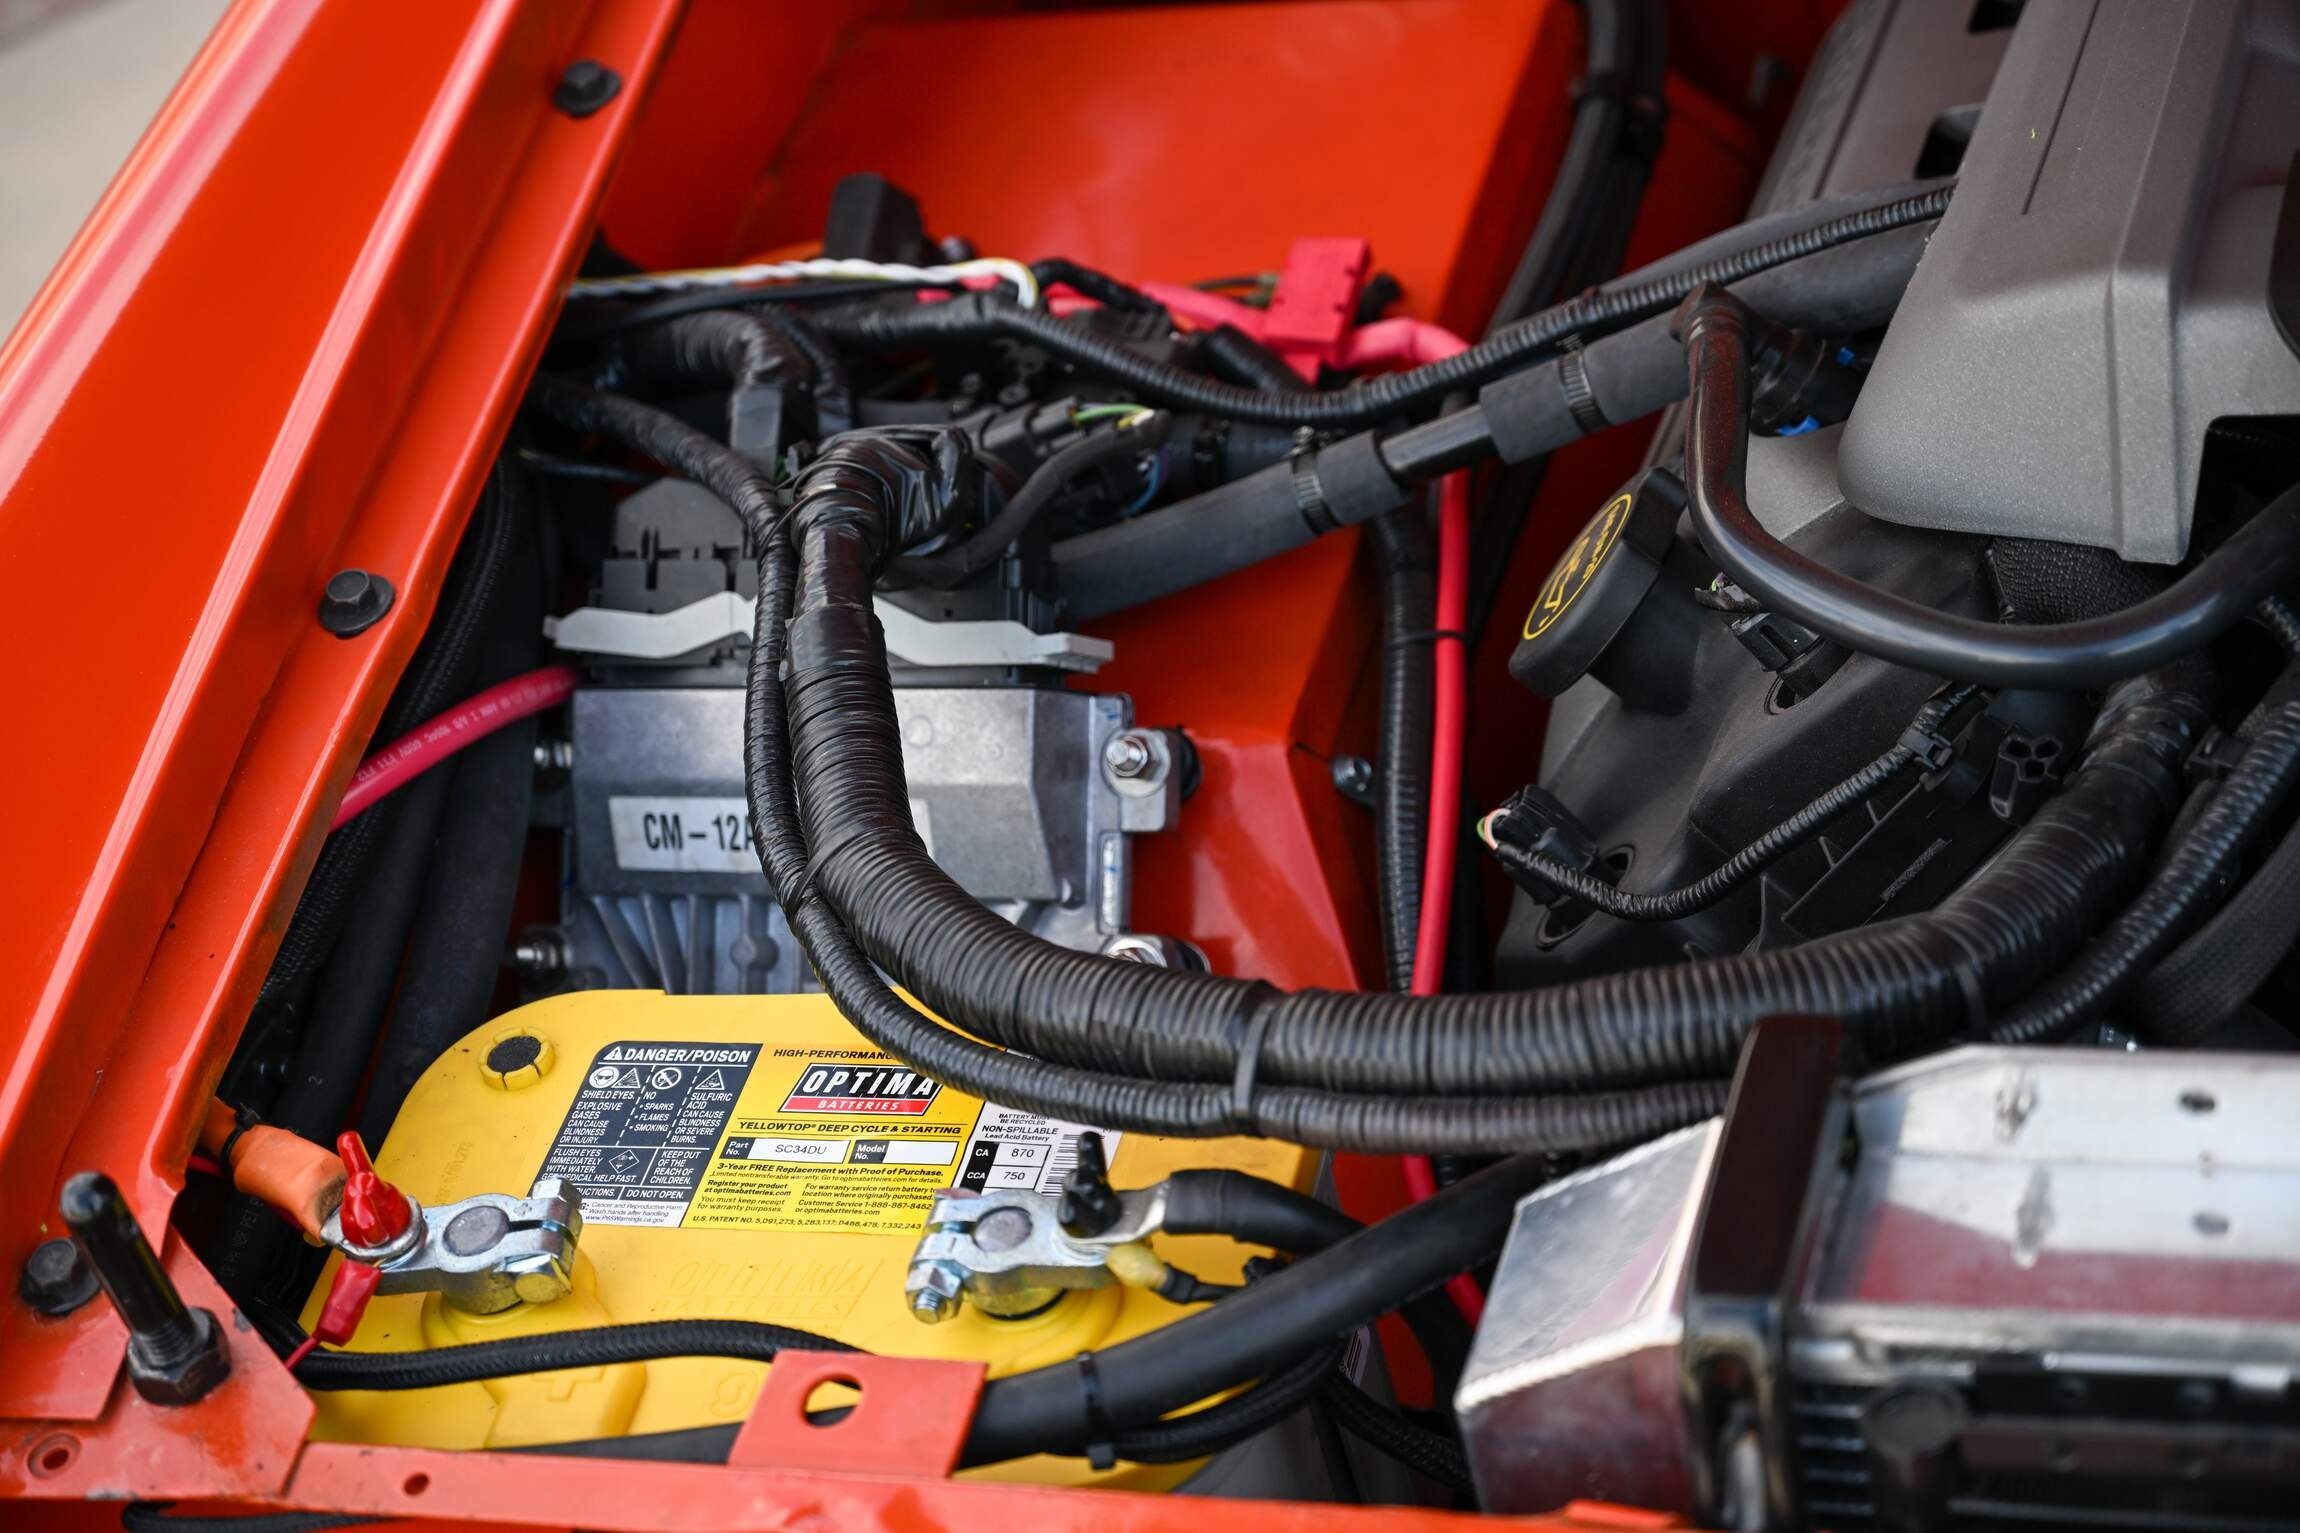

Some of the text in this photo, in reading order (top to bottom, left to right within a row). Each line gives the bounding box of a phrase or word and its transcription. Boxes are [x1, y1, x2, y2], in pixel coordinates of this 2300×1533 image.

[624, 1048, 751, 1063] DANGER/POISON
[802, 1070, 935, 1096] OPTIMA
[582, 1090, 635, 1100] SHIELD EYES.
[643, 1091, 657, 1100] NO
[691, 1092, 733, 1102] SULFURIC
[576, 1101, 623, 1111] EXPLOSIVE
[644, 1103, 674, 1111] SPARKS
[686, 1101, 707, 1109] ACID
[818, 1100, 900, 1111] BATTERIES
[571, 1111, 601, 1119] GASES
[639, 1113, 670, 1121] FLAMES
[699, 1111, 725, 1119] CAUSE
[584, 1120, 609, 1128] CAUSE
[678, 1119, 721, 1127] BLINDNESS
[563, 1128, 606, 1136] BLINDNESS
[634, 1124, 669, 1132] SMOKING
[817, 1124, 850, 1132] DEEP
[850, 1125, 890, 1133] CYCLE
[901, 1126, 961, 1134] STARTING
[982, 1125, 1059, 1135] NON-SPILLABLE
[728, 1141, 749, 1149] Part
[856, 1144, 886, 1153] Model
[553, 1148, 602, 1157] FLUSH EYES
[775, 1144, 827, 1155] SC34DU
[975, 1149, 989, 1157] CA
[1011, 1149, 1034, 1158] 870
[549, 1157, 603, 1165] IMMEDIATELY
[658, 1159, 670, 1167] OF
[568, 1165, 596, 1174] WATER.
[654, 1167, 694, 1176] REACH OF
[775, 1165, 836, 1174] Replacement
[898, 1168, 943, 1176] Purchase.
[594, 1174, 616, 1182] HELP
[615, 1175, 637, 1183] FAST.
[650, 1176, 691, 1184] CHILDREN.
[967, 1172, 986, 1180] CCA
[1003, 1172, 1025, 1180] 750
[626, 1189, 684, 1199] DO NOT OPEN.
[713, 1188, 791, 1196] optimabatteries.com
[901, 1186, 928, 1194] battery
[857, 1192, 891, 1200] originally
